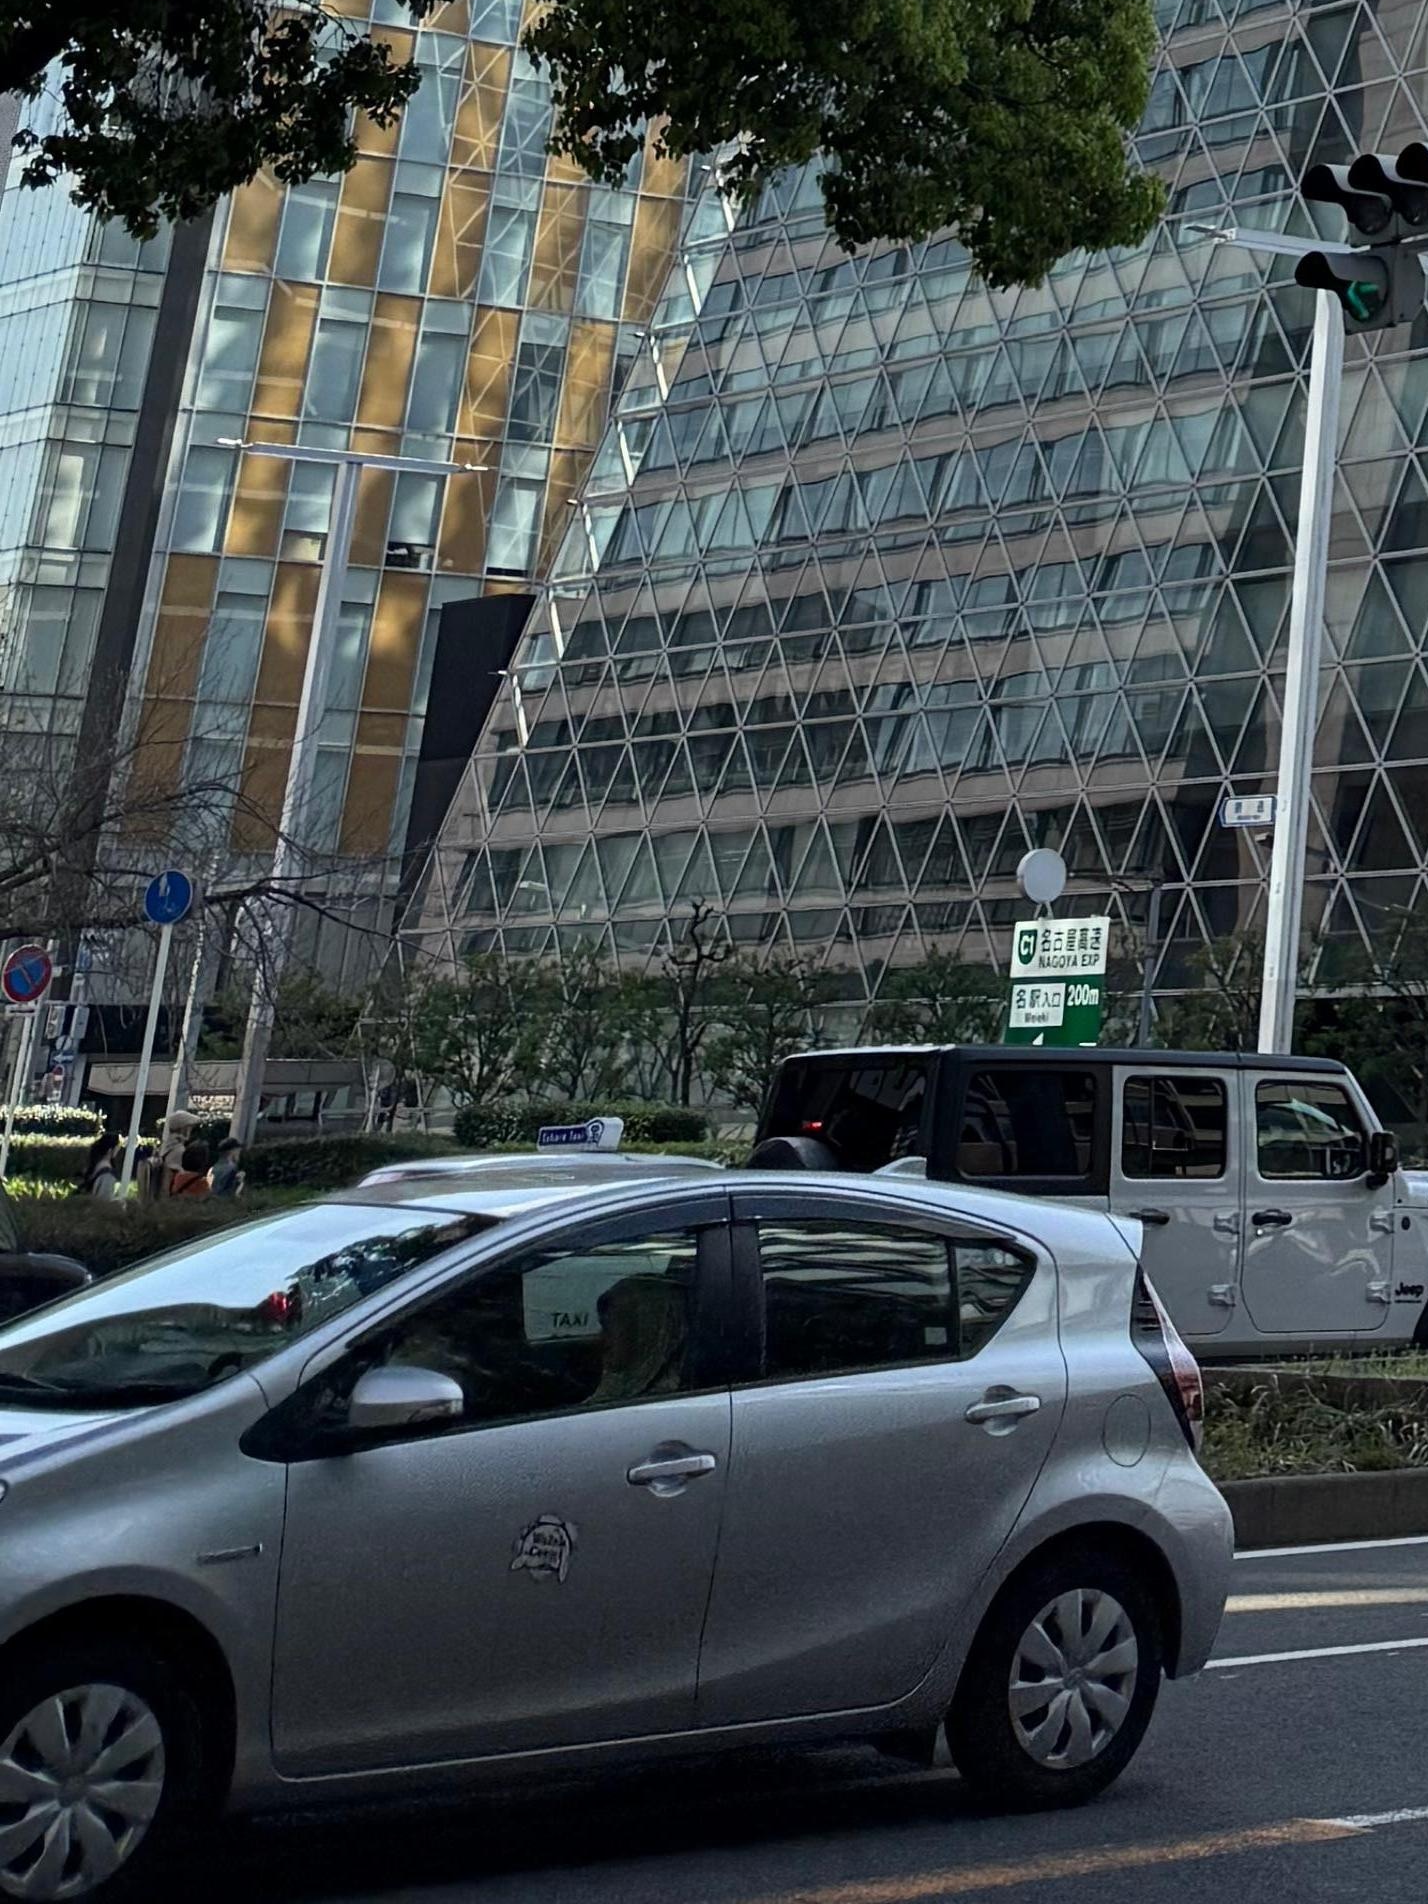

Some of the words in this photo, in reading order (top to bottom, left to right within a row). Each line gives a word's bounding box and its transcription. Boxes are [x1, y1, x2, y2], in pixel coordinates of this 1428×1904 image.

[1041, 927, 1103, 952] 名古屋高速
[1039, 955, 1078, 969] NAGOYA
[1081, 953, 1100, 967] EXP
[1016, 988, 1062, 1010] 名駅入口
[1067, 983, 1099, 1007] 200m
[1395, 1281, 1424, 1298] Jeep
[551, 1312, 589, 1328] TAXI
